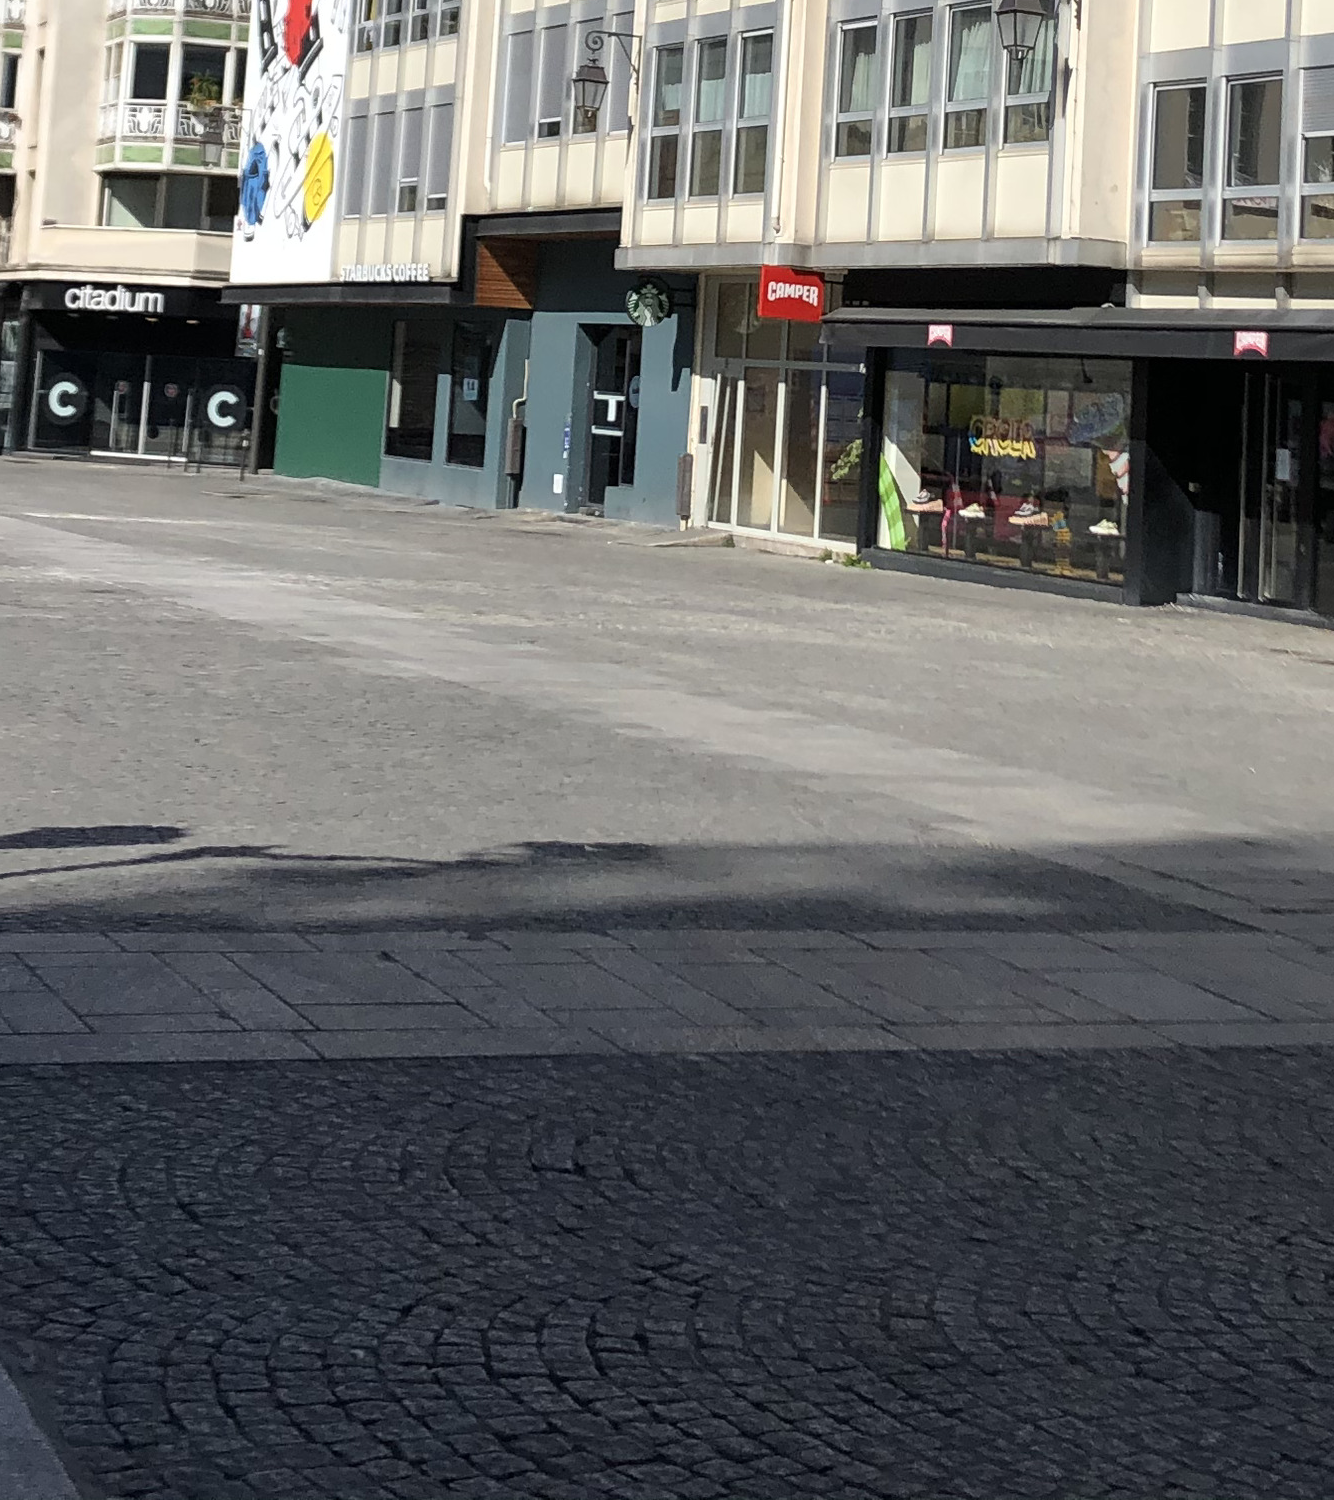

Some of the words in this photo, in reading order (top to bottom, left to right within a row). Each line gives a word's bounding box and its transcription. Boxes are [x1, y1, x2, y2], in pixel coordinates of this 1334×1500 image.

[339, 263, 392, 283] STARBUCKS
[393, 262, 430, 283] COFFEE
[64, 284, 165, 313] citadium
[767, 281, 819, 307] CAMPER
